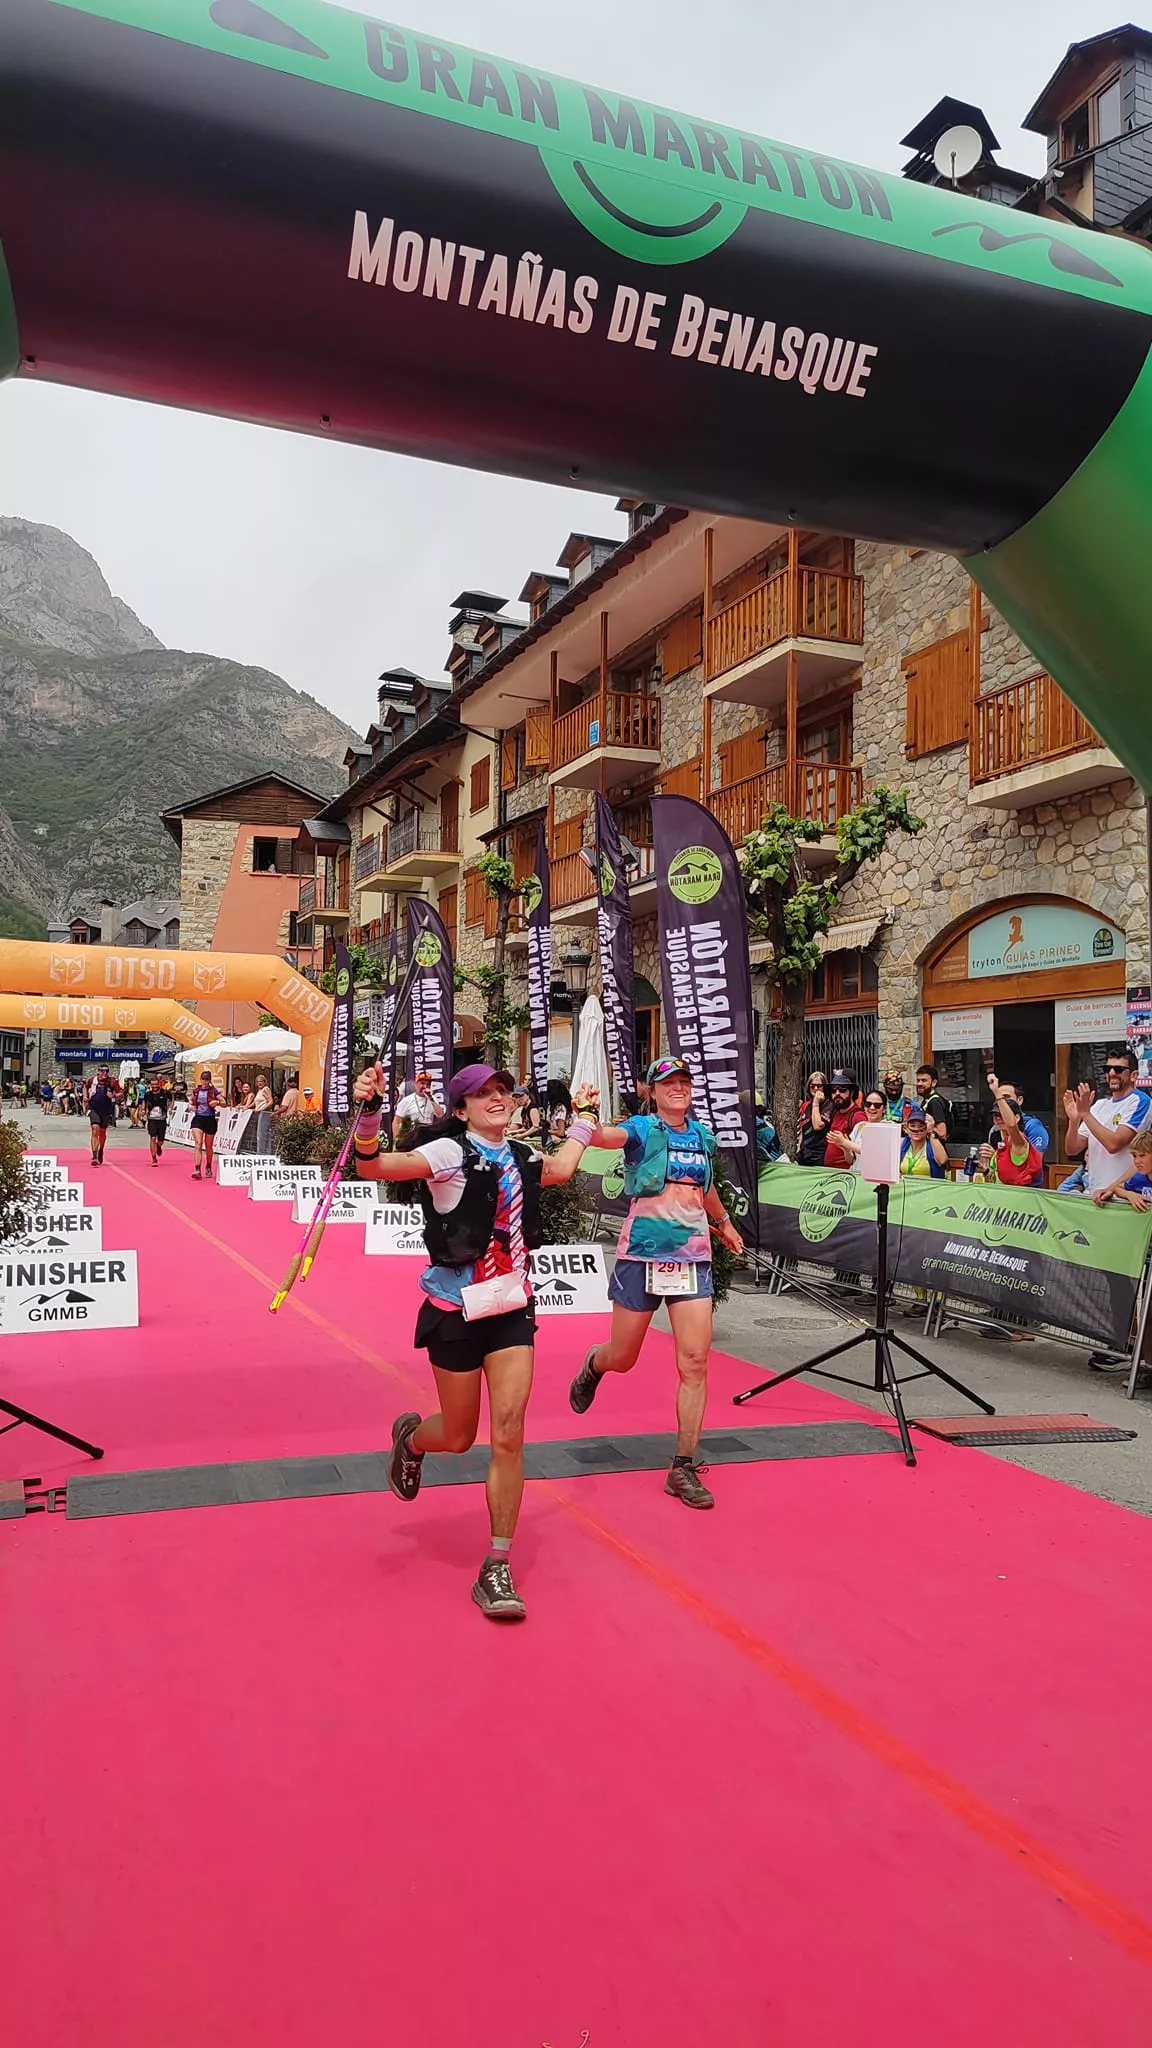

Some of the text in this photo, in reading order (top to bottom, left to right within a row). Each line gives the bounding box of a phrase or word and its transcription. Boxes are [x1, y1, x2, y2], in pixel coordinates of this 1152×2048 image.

[363, 20, 561, 132] GRAN
[347, 209, 879, 398] MONTAÑAS DE BENASQUE
[972, 956, 1002, 969] tryton
[1040, 943, 1081, 958] PIRINEO
[104, 956, 175, 991] OTSO
[279, 975, 331, 1023] OTSO
[57, 1002, 104, 1026] OTSO
[171, 1014, 210, 1043] OTSO
[256, 1169, 317, 1181] FINISHER
[963, 1203, 1048, 1235] GRAN MARATÓN
[0, 1260, 127, 1287] INISHER
[658, 1261, 682, 1273] 291
[978, 1249, 990, 1262] DE
[988, 1250, 1030, 1273] BENASQUE
[921, 1256, 1046, 1297] granmaratonbenasque.es
[28, 1306, 88, 1322] GMMB
